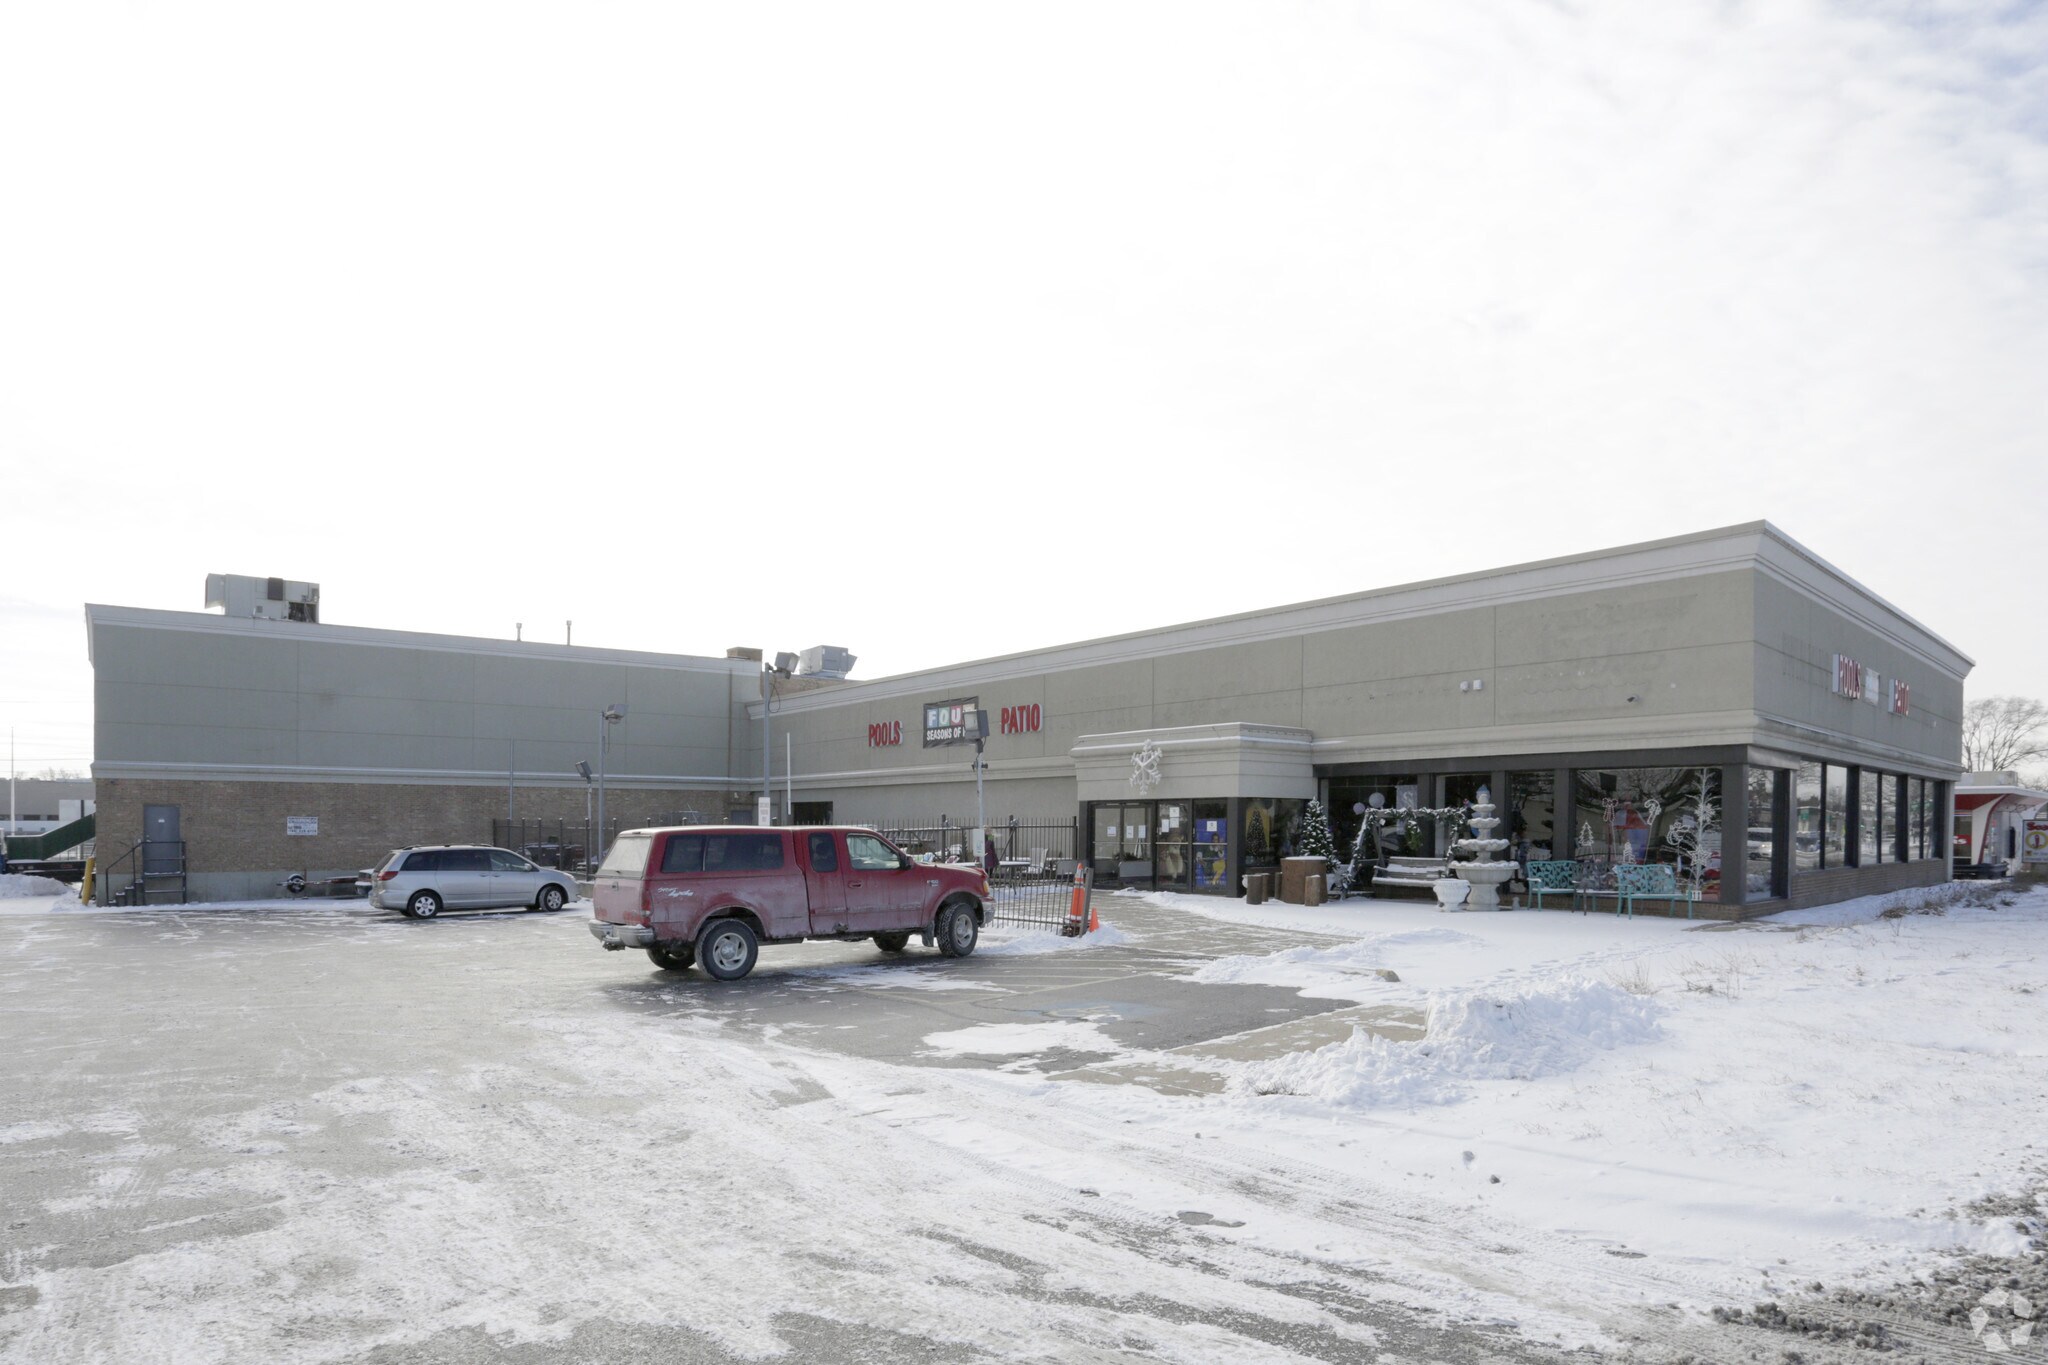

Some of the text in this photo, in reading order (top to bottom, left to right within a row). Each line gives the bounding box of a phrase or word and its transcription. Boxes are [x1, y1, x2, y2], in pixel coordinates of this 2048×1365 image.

[1836, 653, 1860, 700] POOLS
[928, 707, 961, 726] FOU
[1001, 703, 1042, 734] PATIO
[869, 720, 902, 747] POOLS
[927, 728, 952, 740] SEASONS
[953, 727, 961, 738] OF
